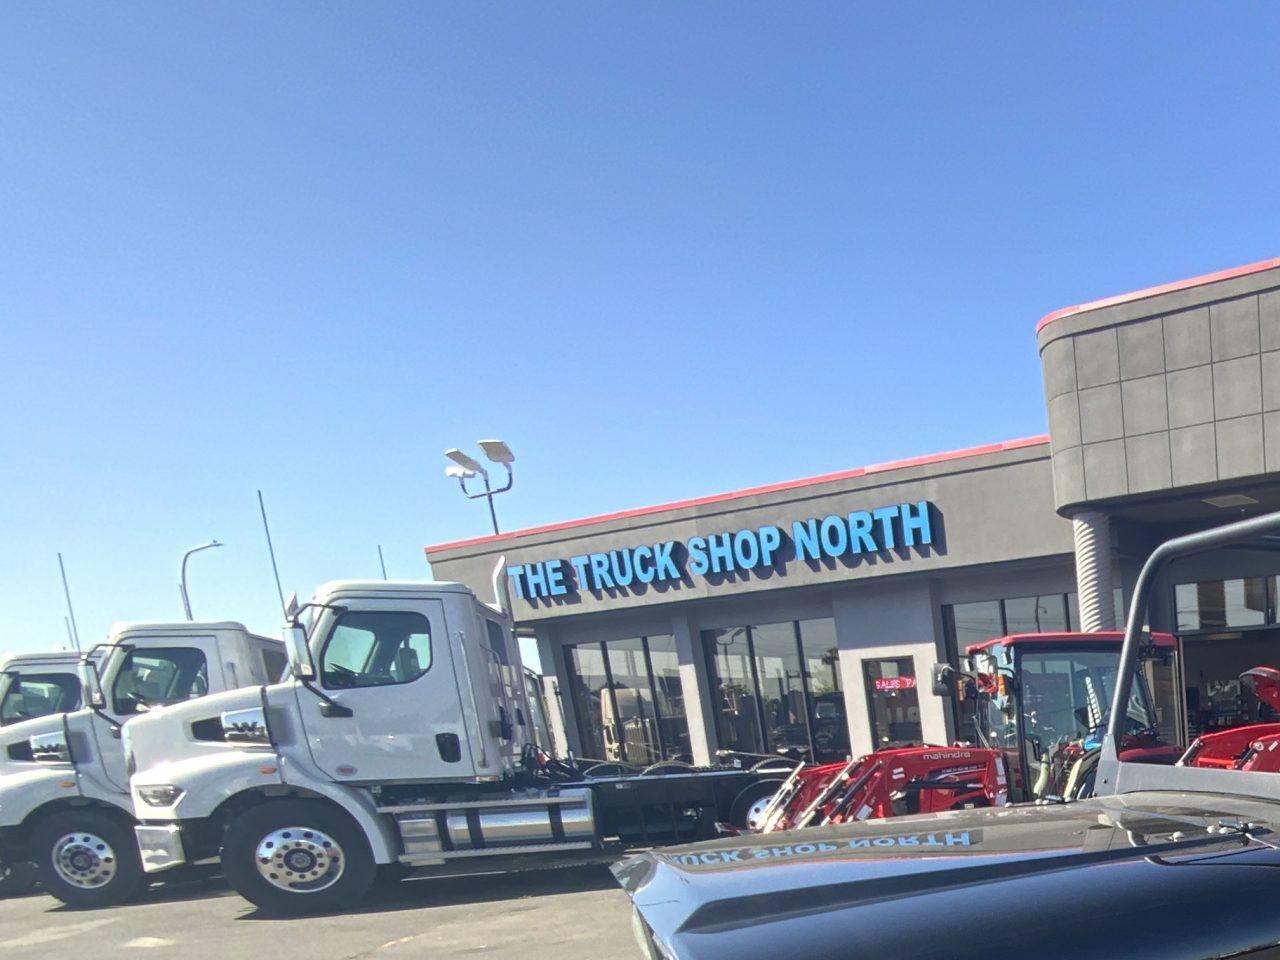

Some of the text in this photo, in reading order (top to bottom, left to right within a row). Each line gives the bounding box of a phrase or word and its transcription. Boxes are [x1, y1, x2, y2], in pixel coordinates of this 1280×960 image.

[507, 500, 932, 600] THE TRUCK SHOP NORTH
[875, 679, 900, 689] SALES
[923, 751, 971, 760] mahindra
